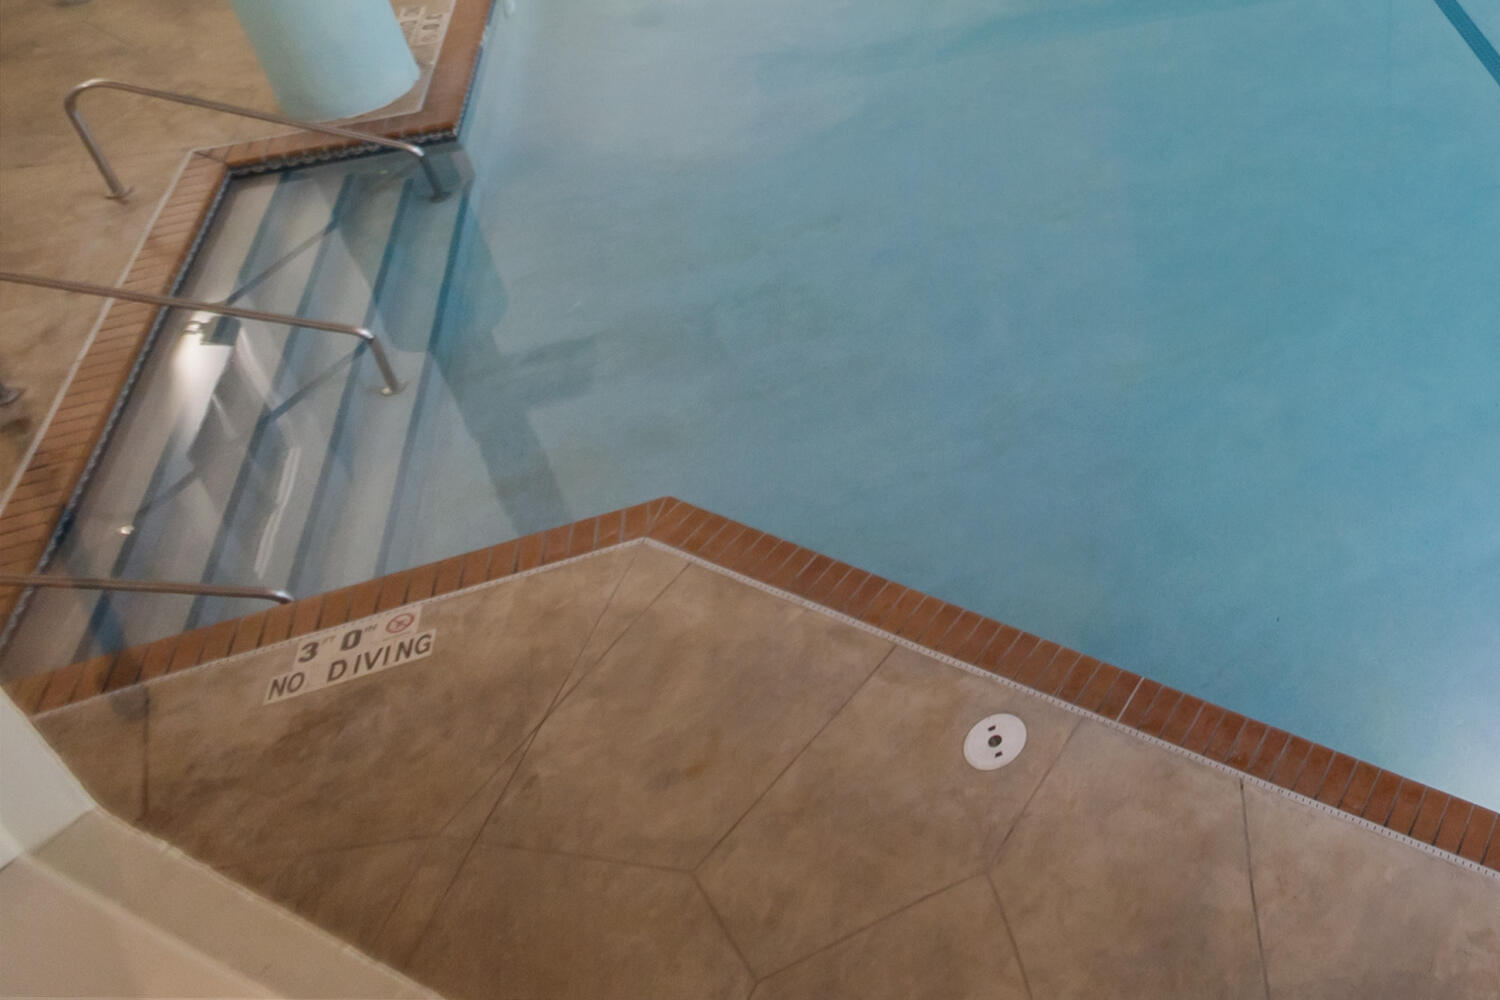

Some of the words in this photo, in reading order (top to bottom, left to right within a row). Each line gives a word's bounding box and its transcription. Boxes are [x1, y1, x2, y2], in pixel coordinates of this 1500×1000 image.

[267, 672, 305, 700] NO
[327, 634, 433, 682] DIVING
[298, 642, 319, 663] 3
[341, 630, 362, 650] 0
